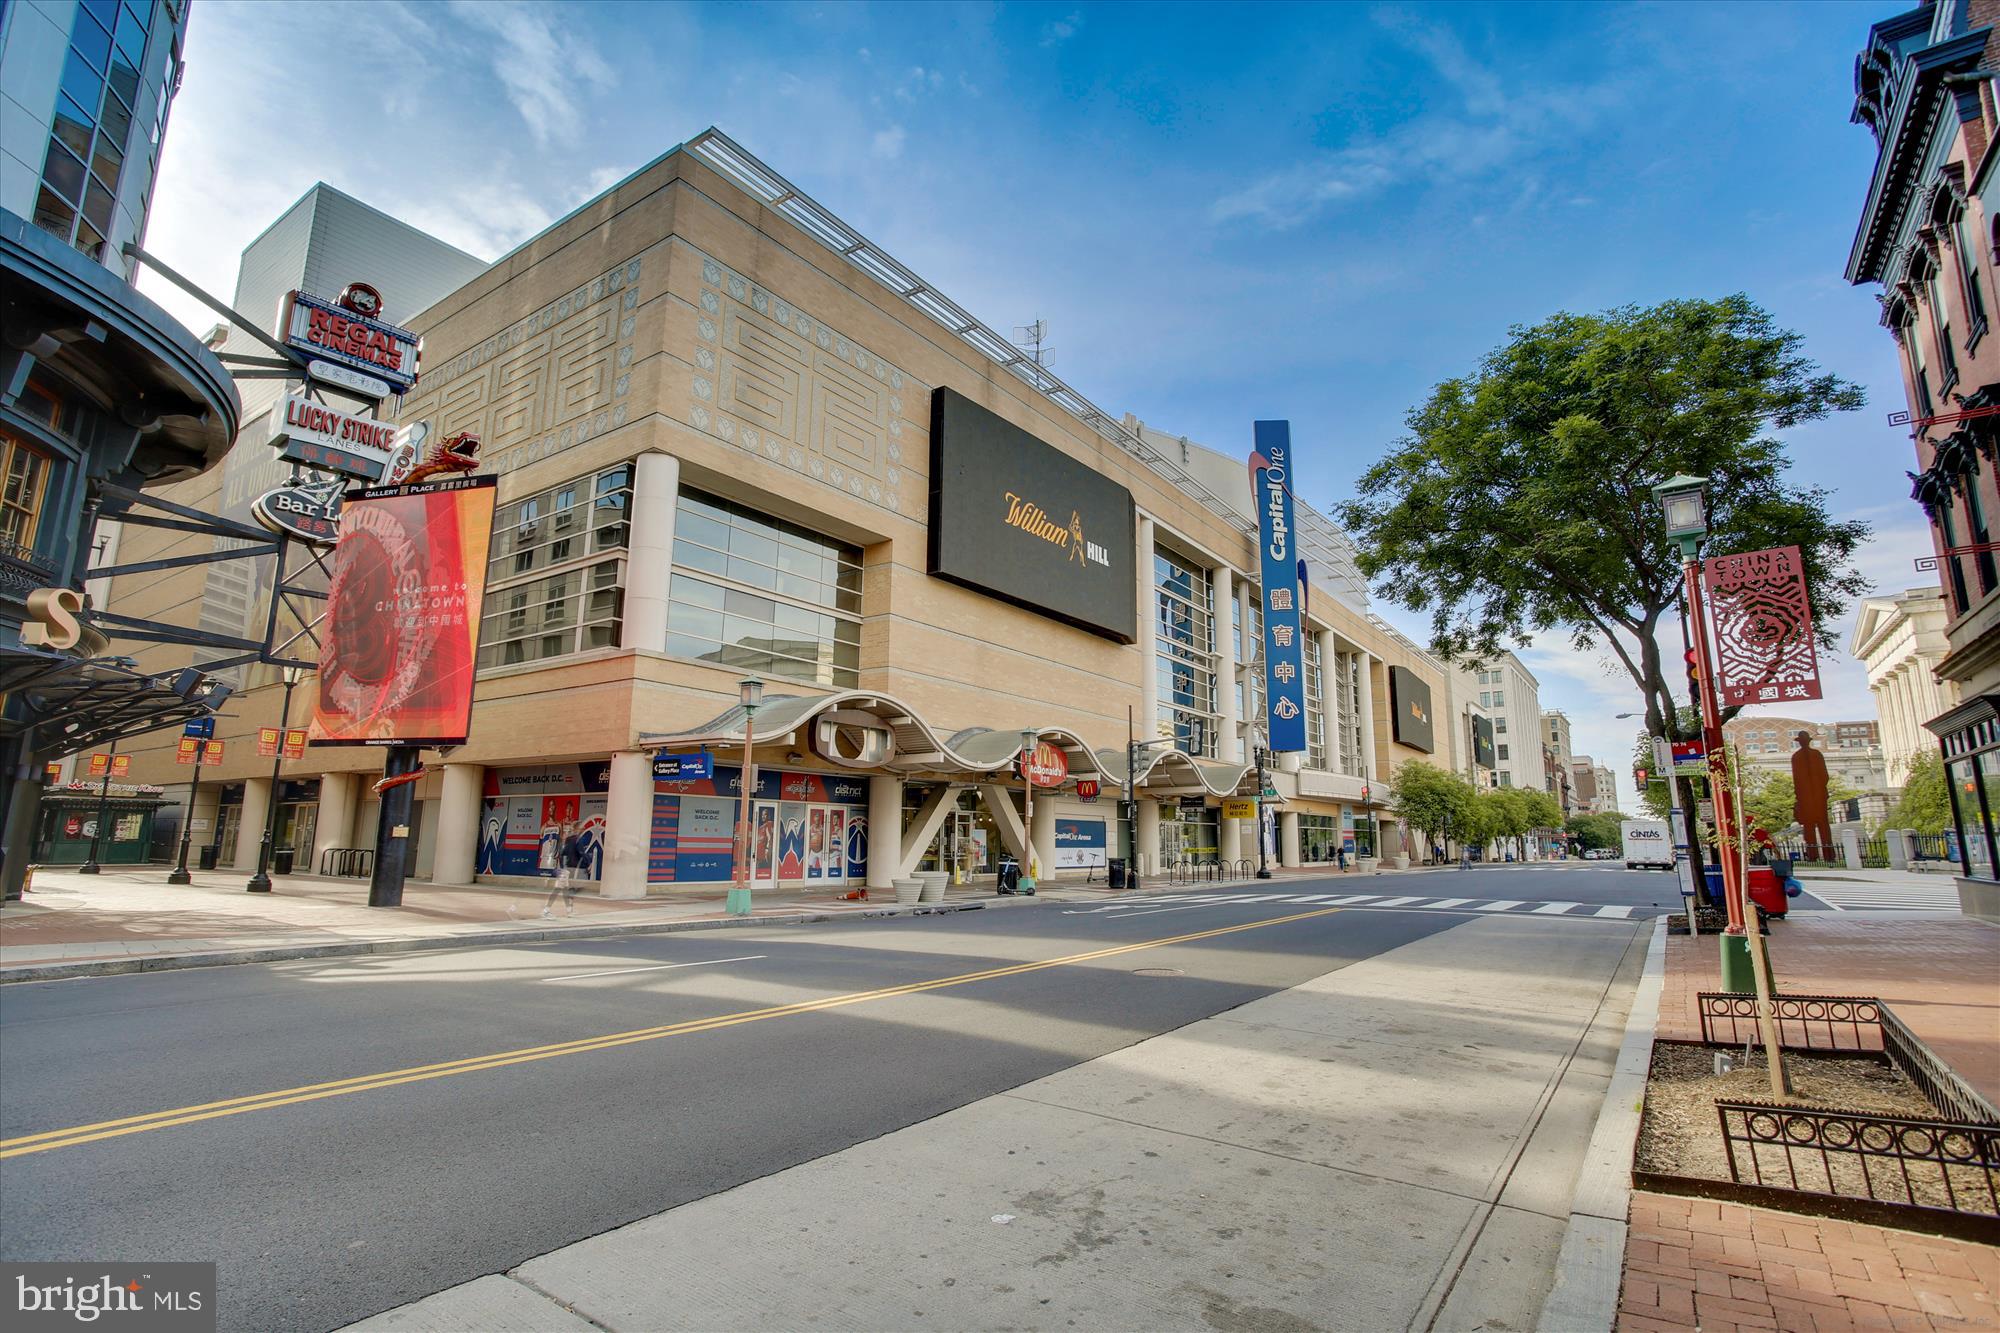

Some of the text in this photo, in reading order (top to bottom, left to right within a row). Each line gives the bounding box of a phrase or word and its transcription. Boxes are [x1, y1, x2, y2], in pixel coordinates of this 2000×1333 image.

[308, 307, 402, 355] REGAL
[307, 327, 402, 370] CINEMAS
[287, 399, 396, 453] LUCKY STRIKE
[317, 434, 361, 452] LANES
[365, 488, 399, 498] GALLERY
[410, 484, 435, 493] PLACE
[275, 495, 320, 516] Bar
[1004, 491, 1111, 567] William HILL
[375, 596, 465, 612] CHINATOWN
[502, 774, 565, 785] WELCOME BACK D.C.
[1228, 802, 1249, 811] Hertz
